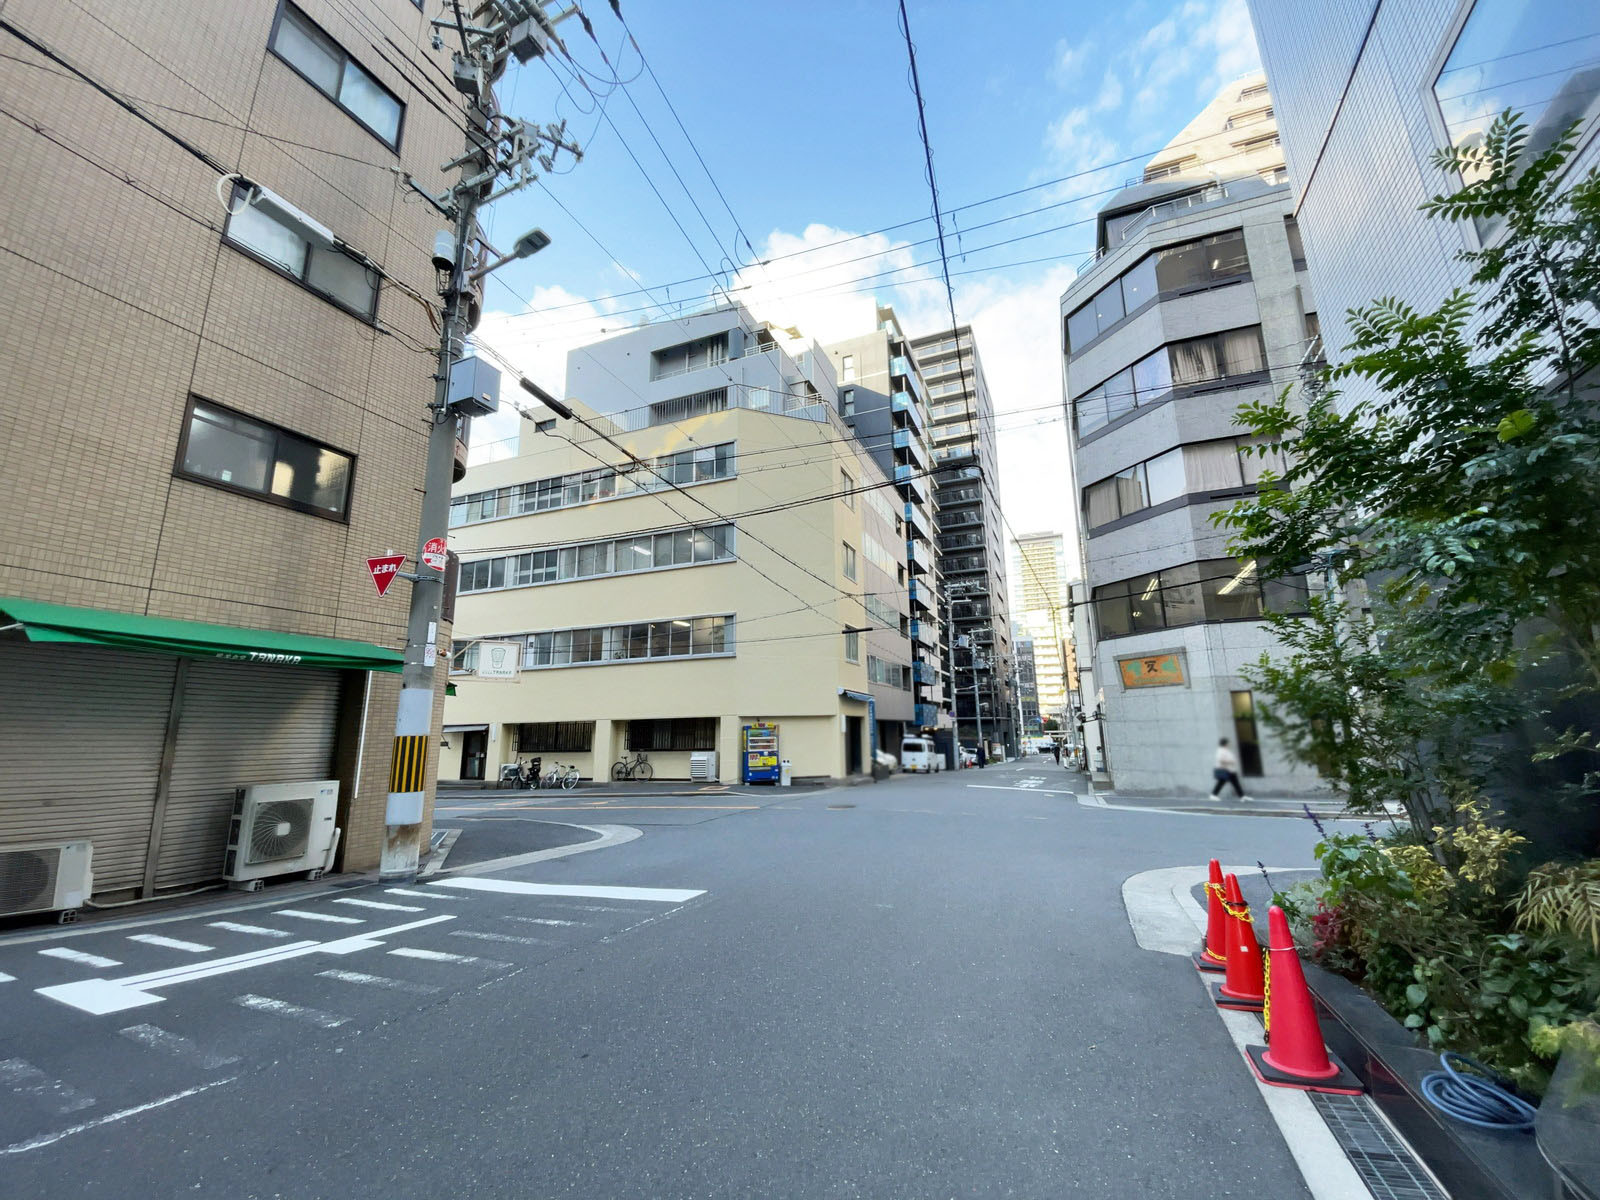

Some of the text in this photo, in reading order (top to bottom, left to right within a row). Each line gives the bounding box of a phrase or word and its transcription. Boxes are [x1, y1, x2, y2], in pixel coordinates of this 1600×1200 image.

[373, 564, 397, 574] 止まれ
[249, 651, 301, 664] TANAKA
